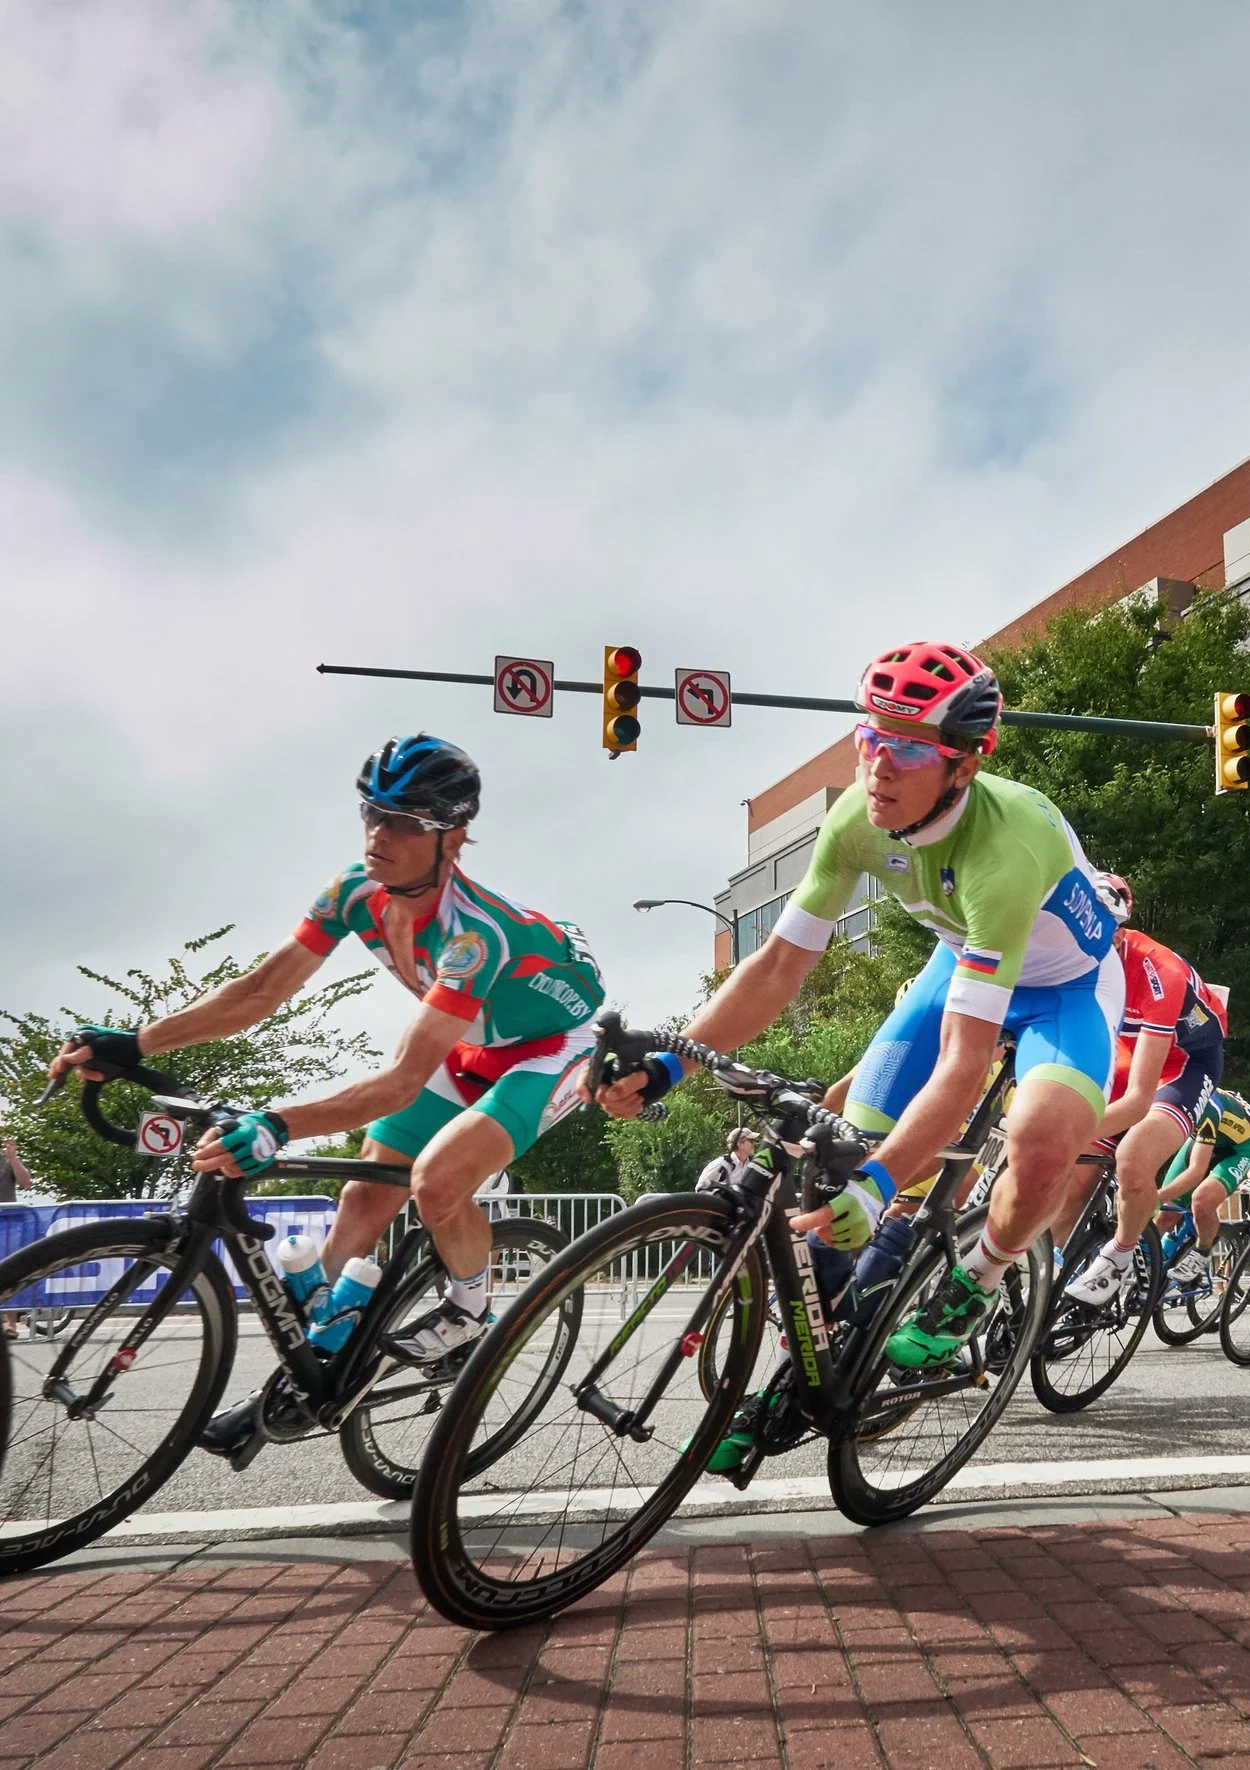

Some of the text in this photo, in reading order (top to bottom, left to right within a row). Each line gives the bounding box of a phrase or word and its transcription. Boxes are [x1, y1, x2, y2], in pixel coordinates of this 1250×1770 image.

[1063, 882, 1103, 941] SOVENIA
[970, 1168, 997, 1206] GIA
[236, 1232, 306, 1350] DOGMA
[789, 1300, 821, 1387] MERIDA
[881, 1391, 922, 1408] ROTOR
